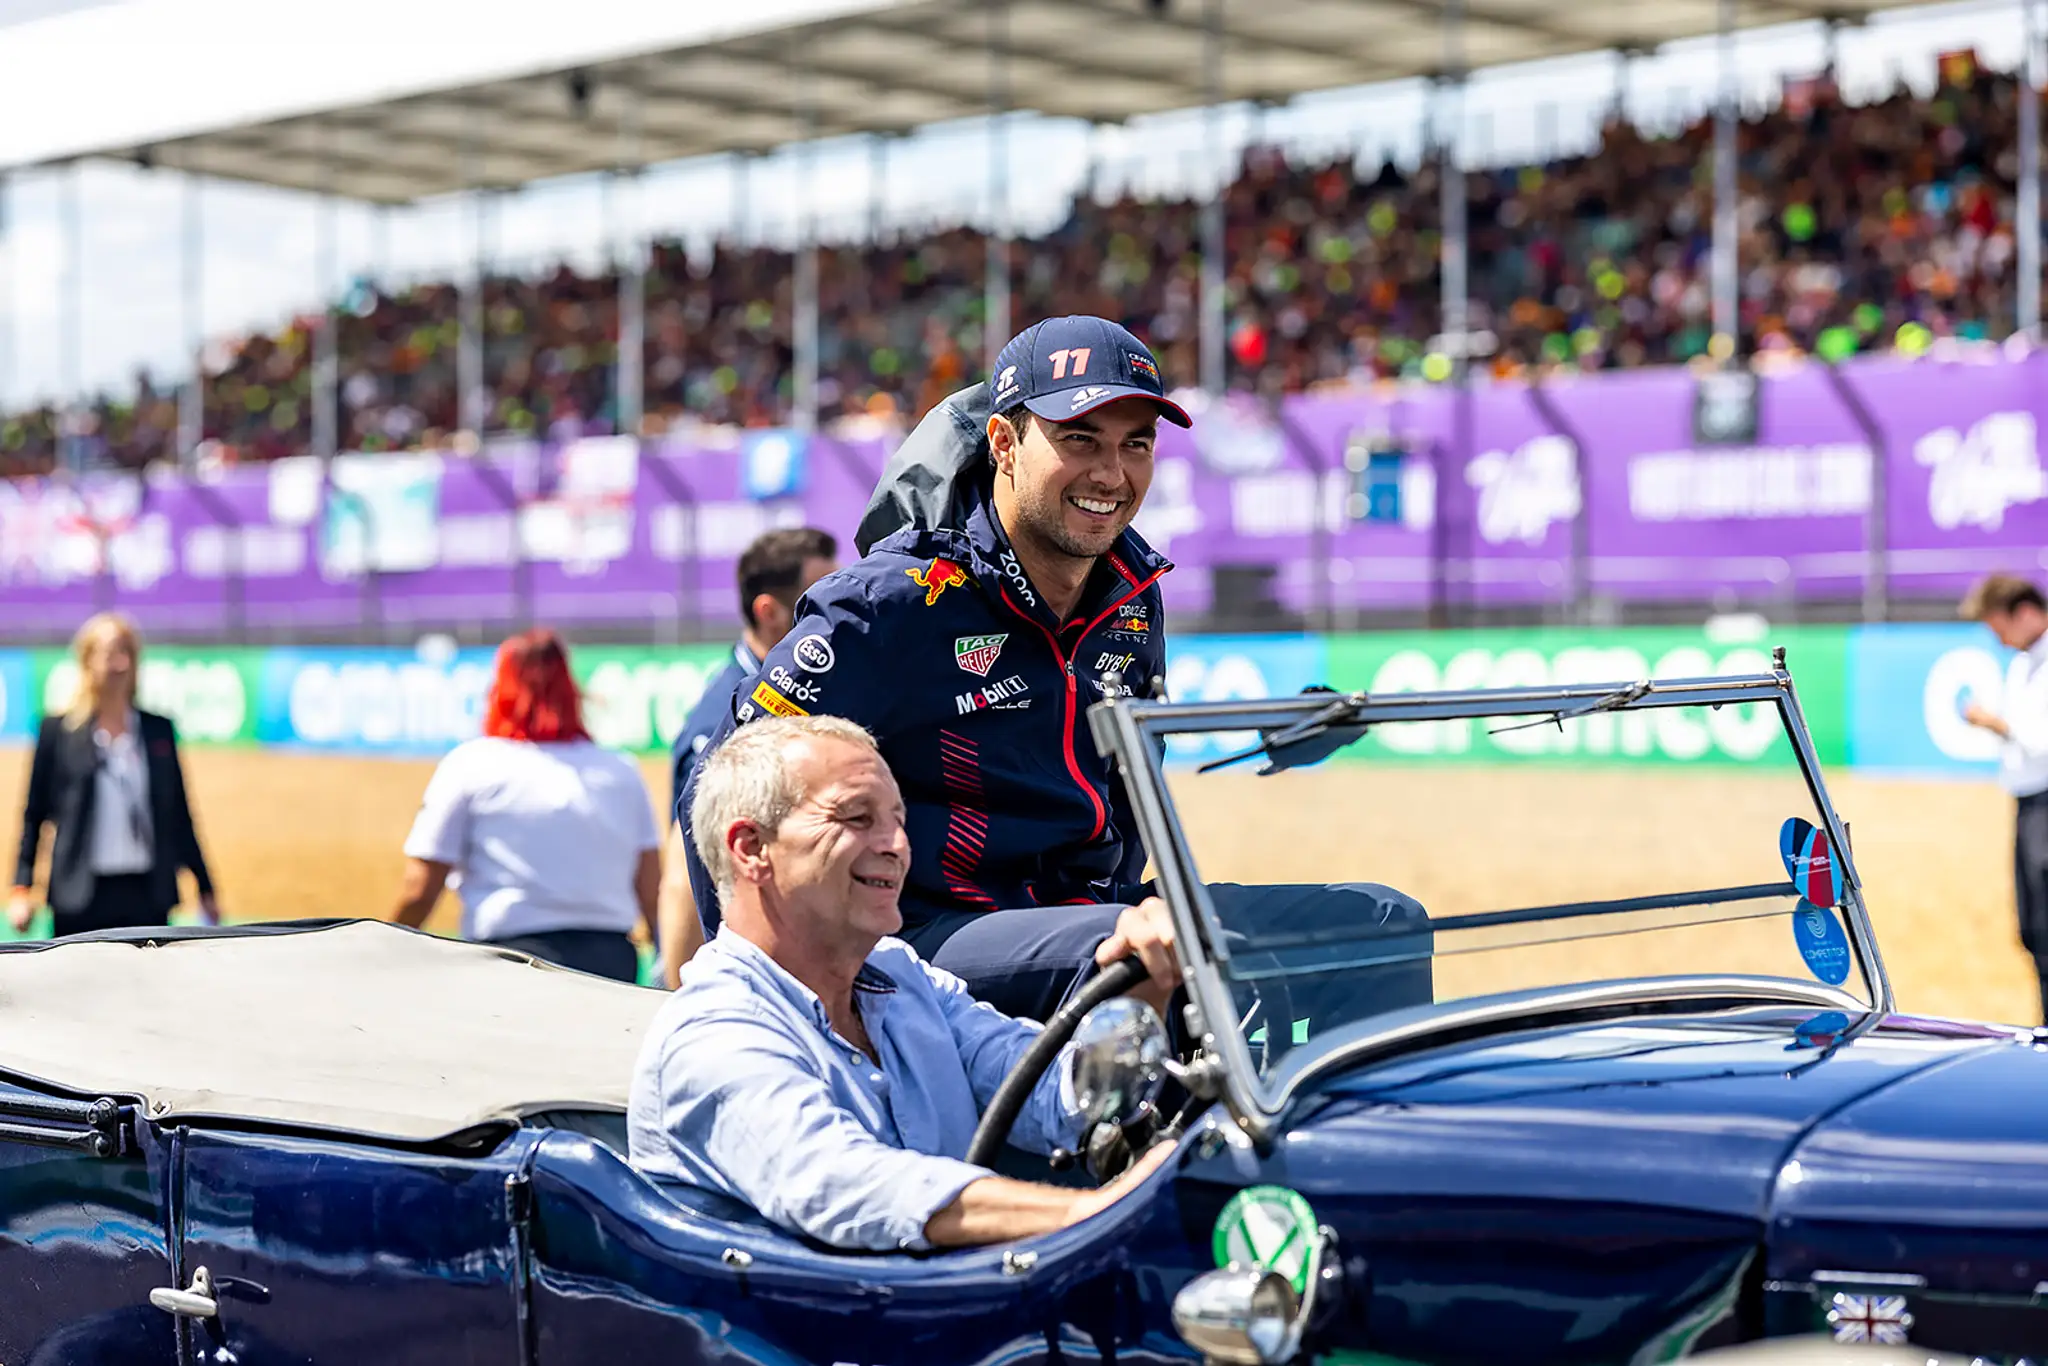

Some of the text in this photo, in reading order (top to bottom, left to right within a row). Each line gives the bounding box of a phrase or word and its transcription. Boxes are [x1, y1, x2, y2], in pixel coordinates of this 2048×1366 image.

[1048, 347, 1092, 381] 11
[958, 645, 1000, 674] HEUER
[959, 636, 1001, 651] TAG
[769, 665, 810, 701] Claro
[955, 681, 1011, 716] Mobil
